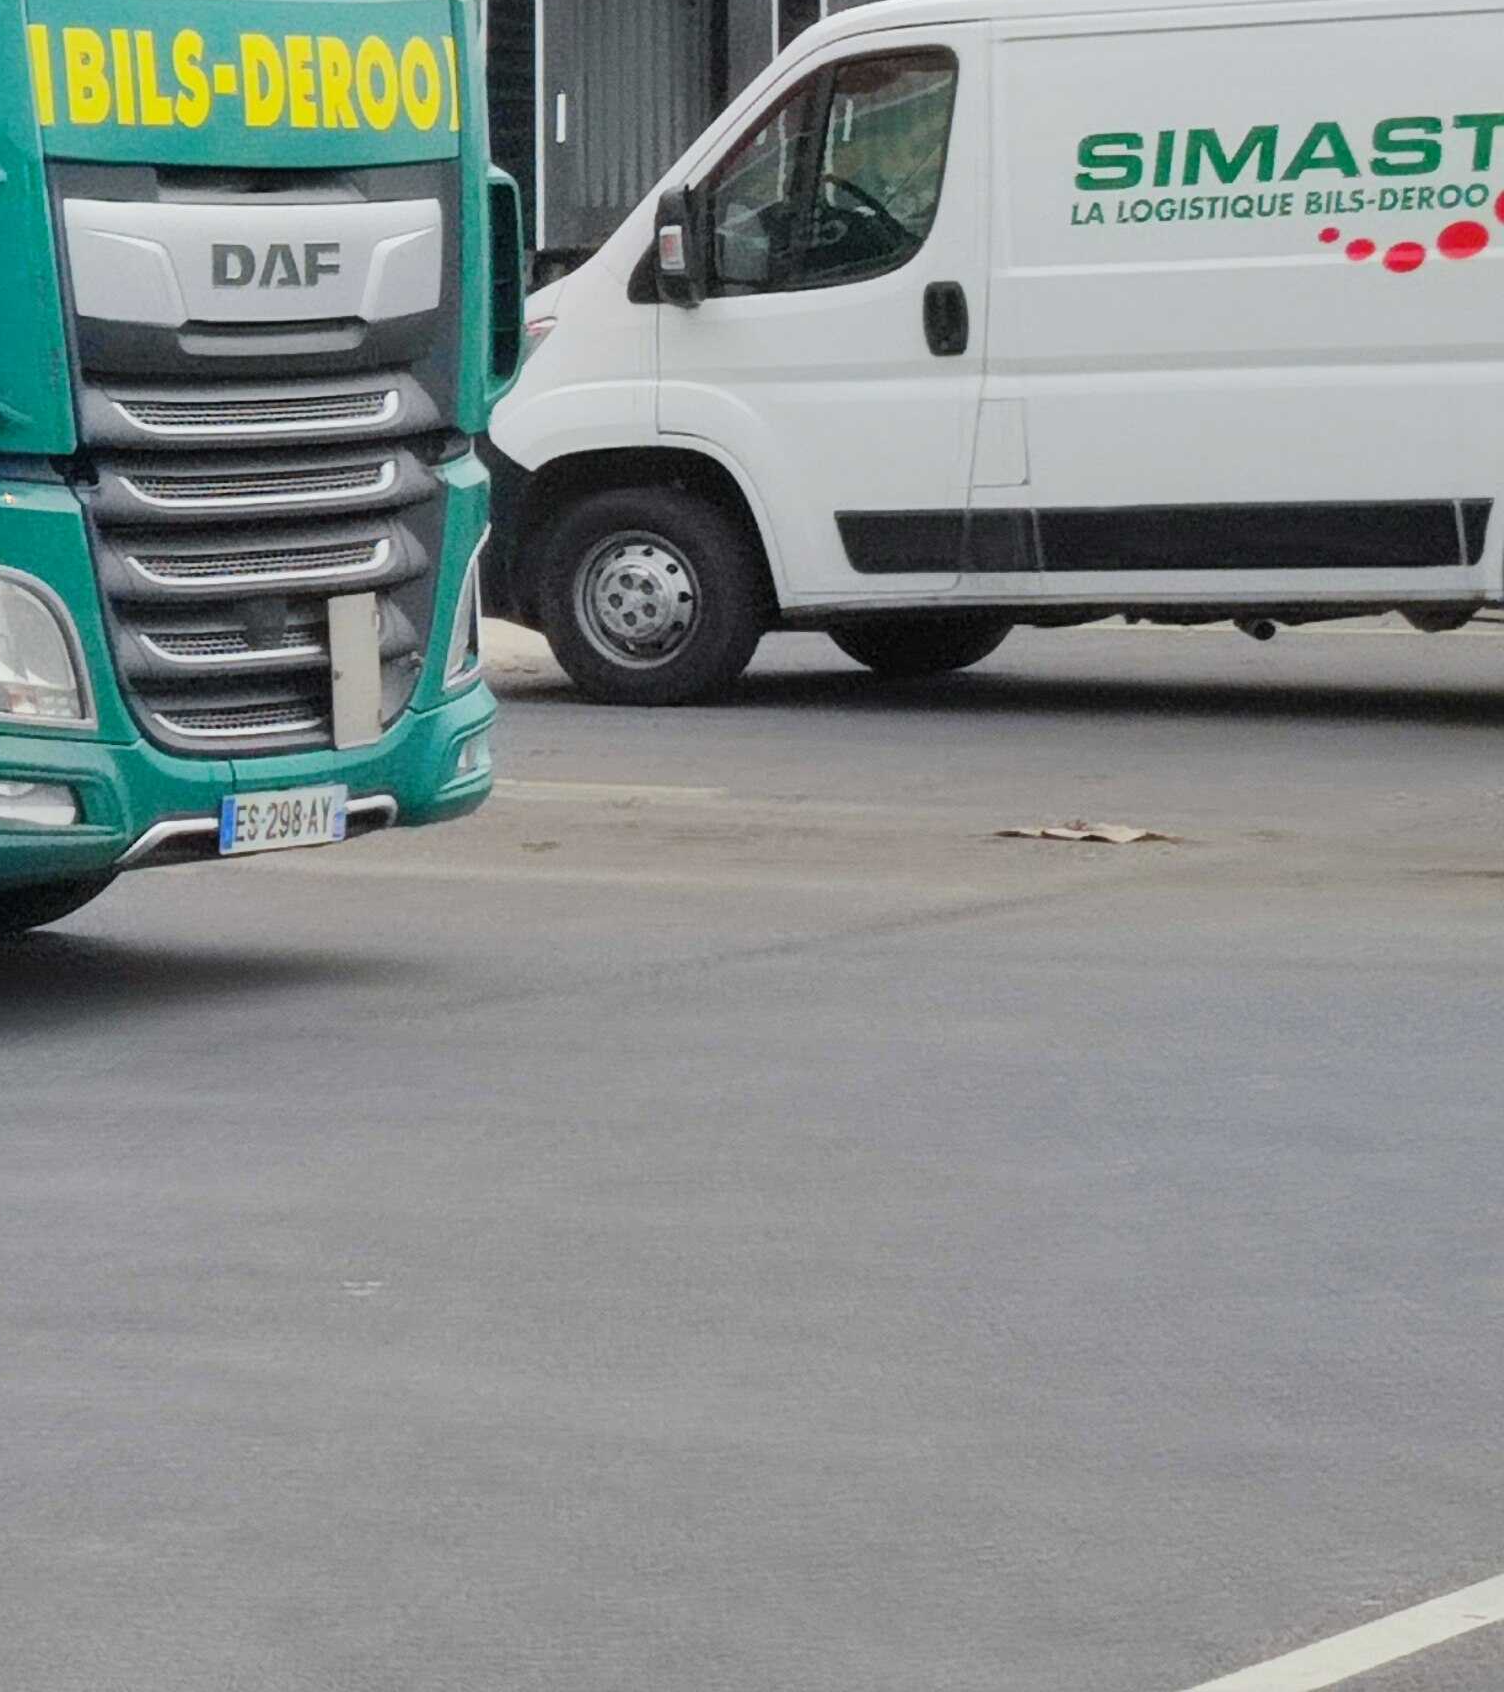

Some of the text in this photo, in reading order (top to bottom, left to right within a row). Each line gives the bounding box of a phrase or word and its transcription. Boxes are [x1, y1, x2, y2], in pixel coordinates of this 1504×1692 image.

[63, 27, 442, 130] BILS-DEROO
[1074, 112, 1504, 191] SIMAST
[1071, 182, 1489, 226] LA LOGISTIQUE BILS-DEROO
[211, 243, 340, 290] DAF
